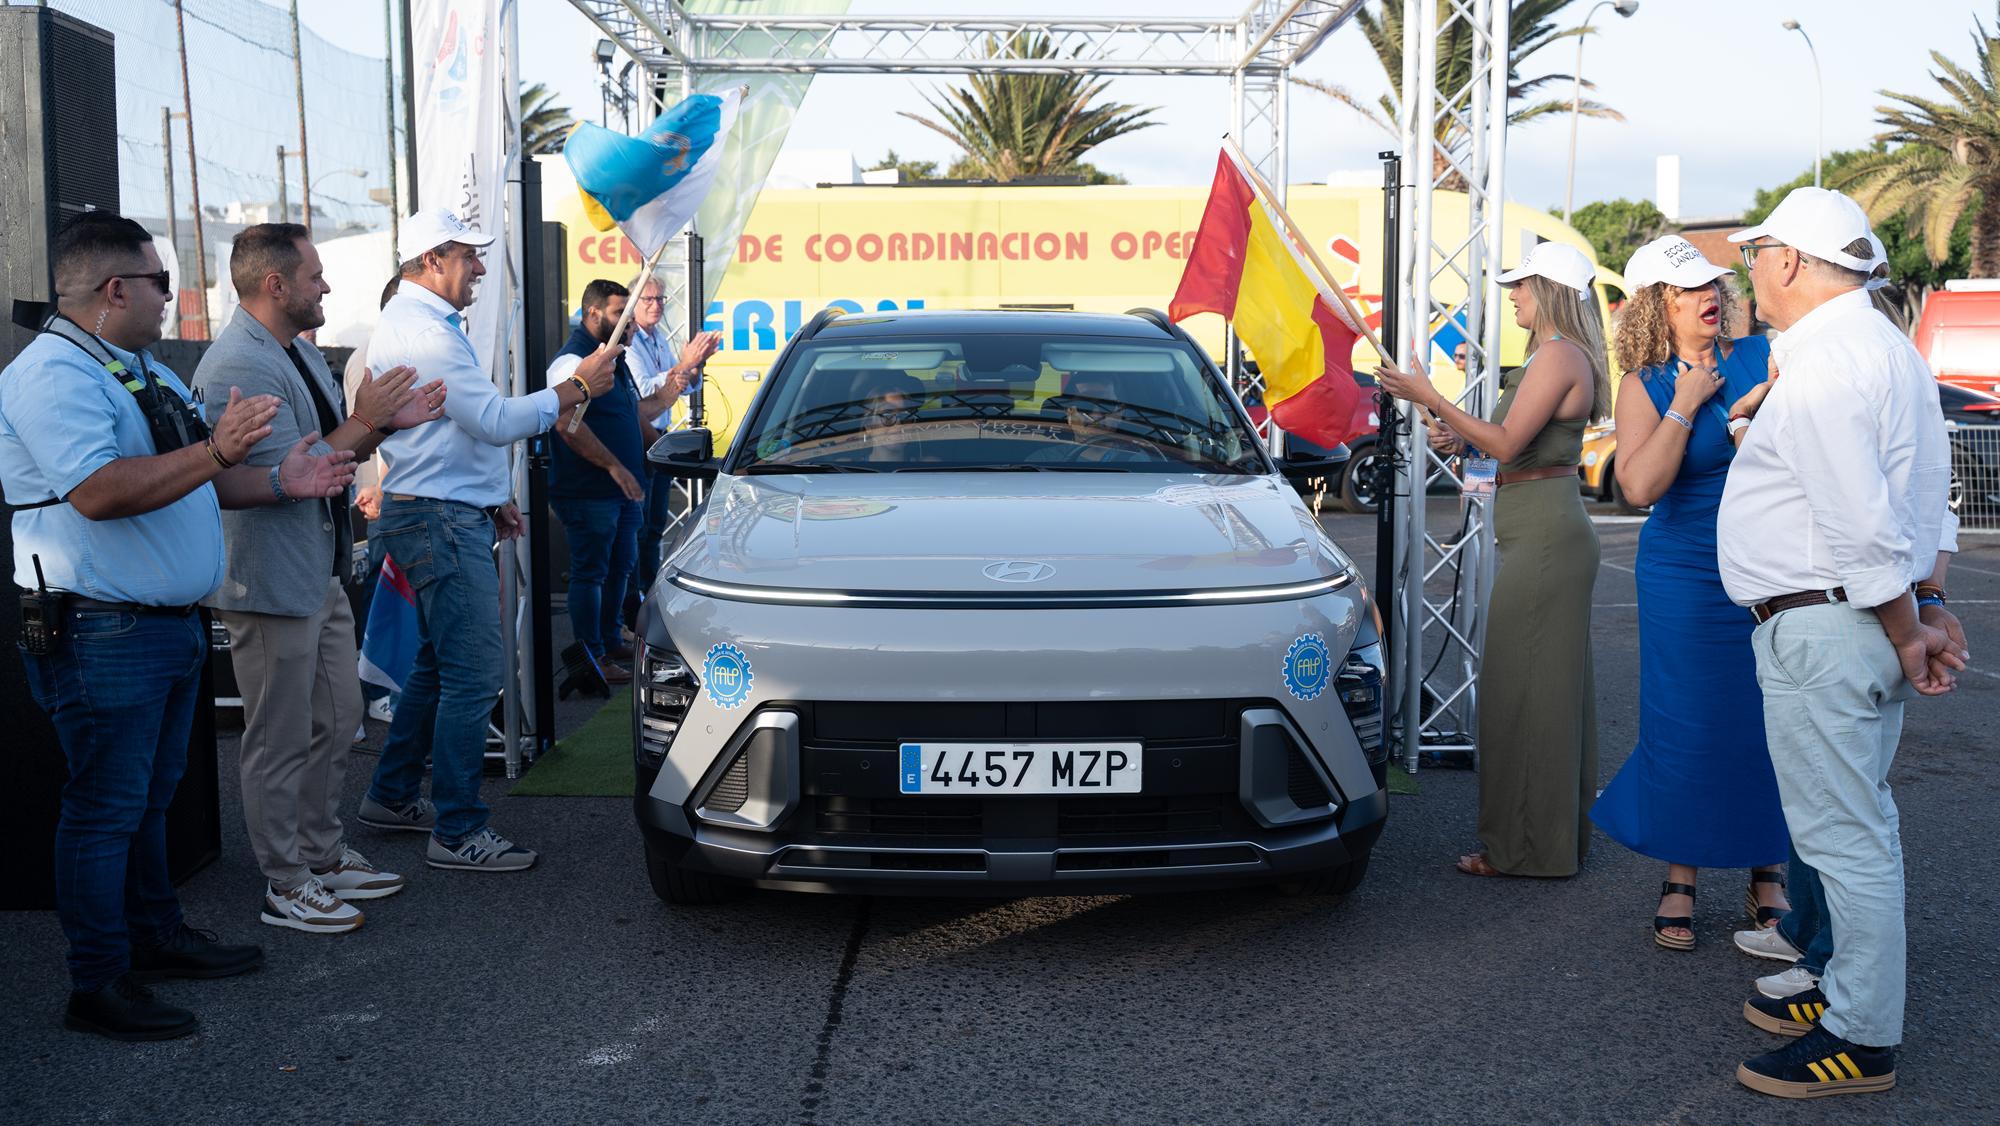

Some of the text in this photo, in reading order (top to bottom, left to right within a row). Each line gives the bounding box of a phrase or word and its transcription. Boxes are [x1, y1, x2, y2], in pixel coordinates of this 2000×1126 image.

[578, 230, 1198, 264] CEN DE COORDINACION OPER
[906, 750, 1129, 788] E 4457 MZP
